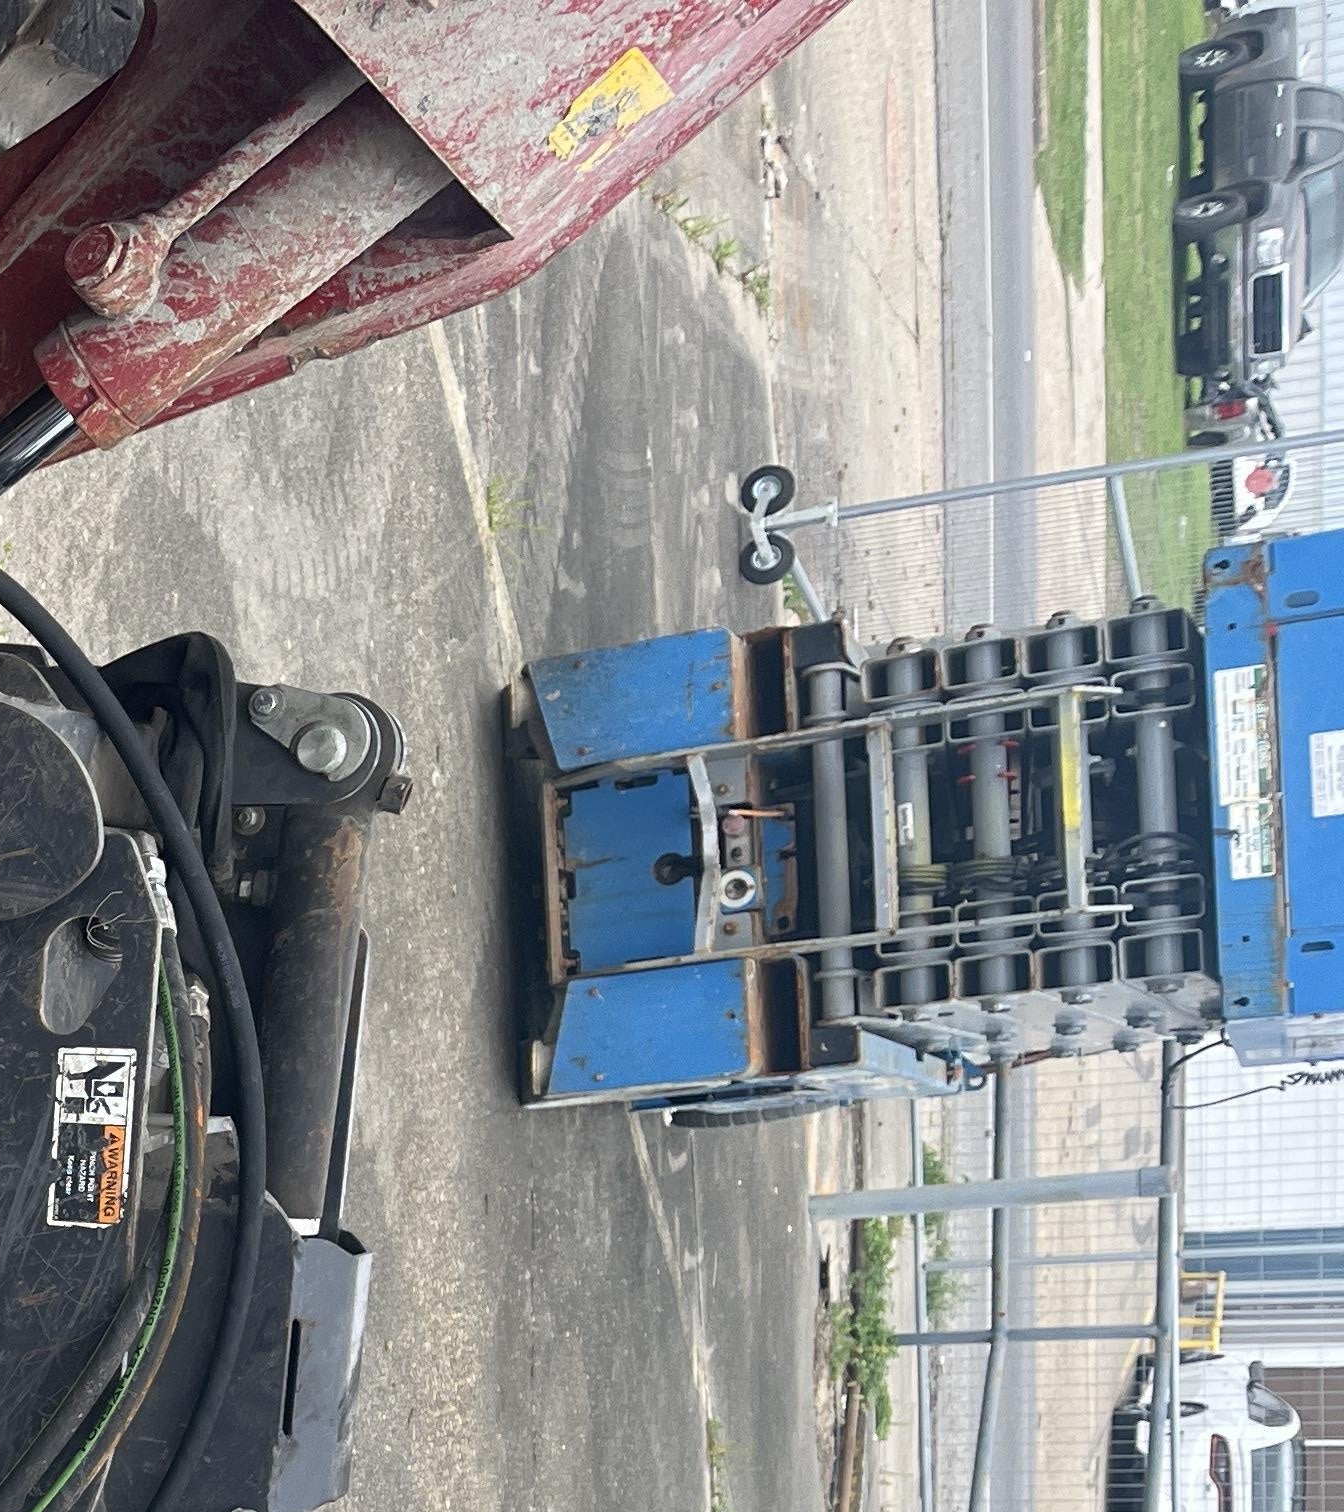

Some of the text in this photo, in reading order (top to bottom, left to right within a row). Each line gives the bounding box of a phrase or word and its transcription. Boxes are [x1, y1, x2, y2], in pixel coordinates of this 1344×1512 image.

[78, 1159, 87, 1193] HAZARD
[88, 1151, 97, 1176] PINCH
[103, 1147, 120, 1217] WARNING
